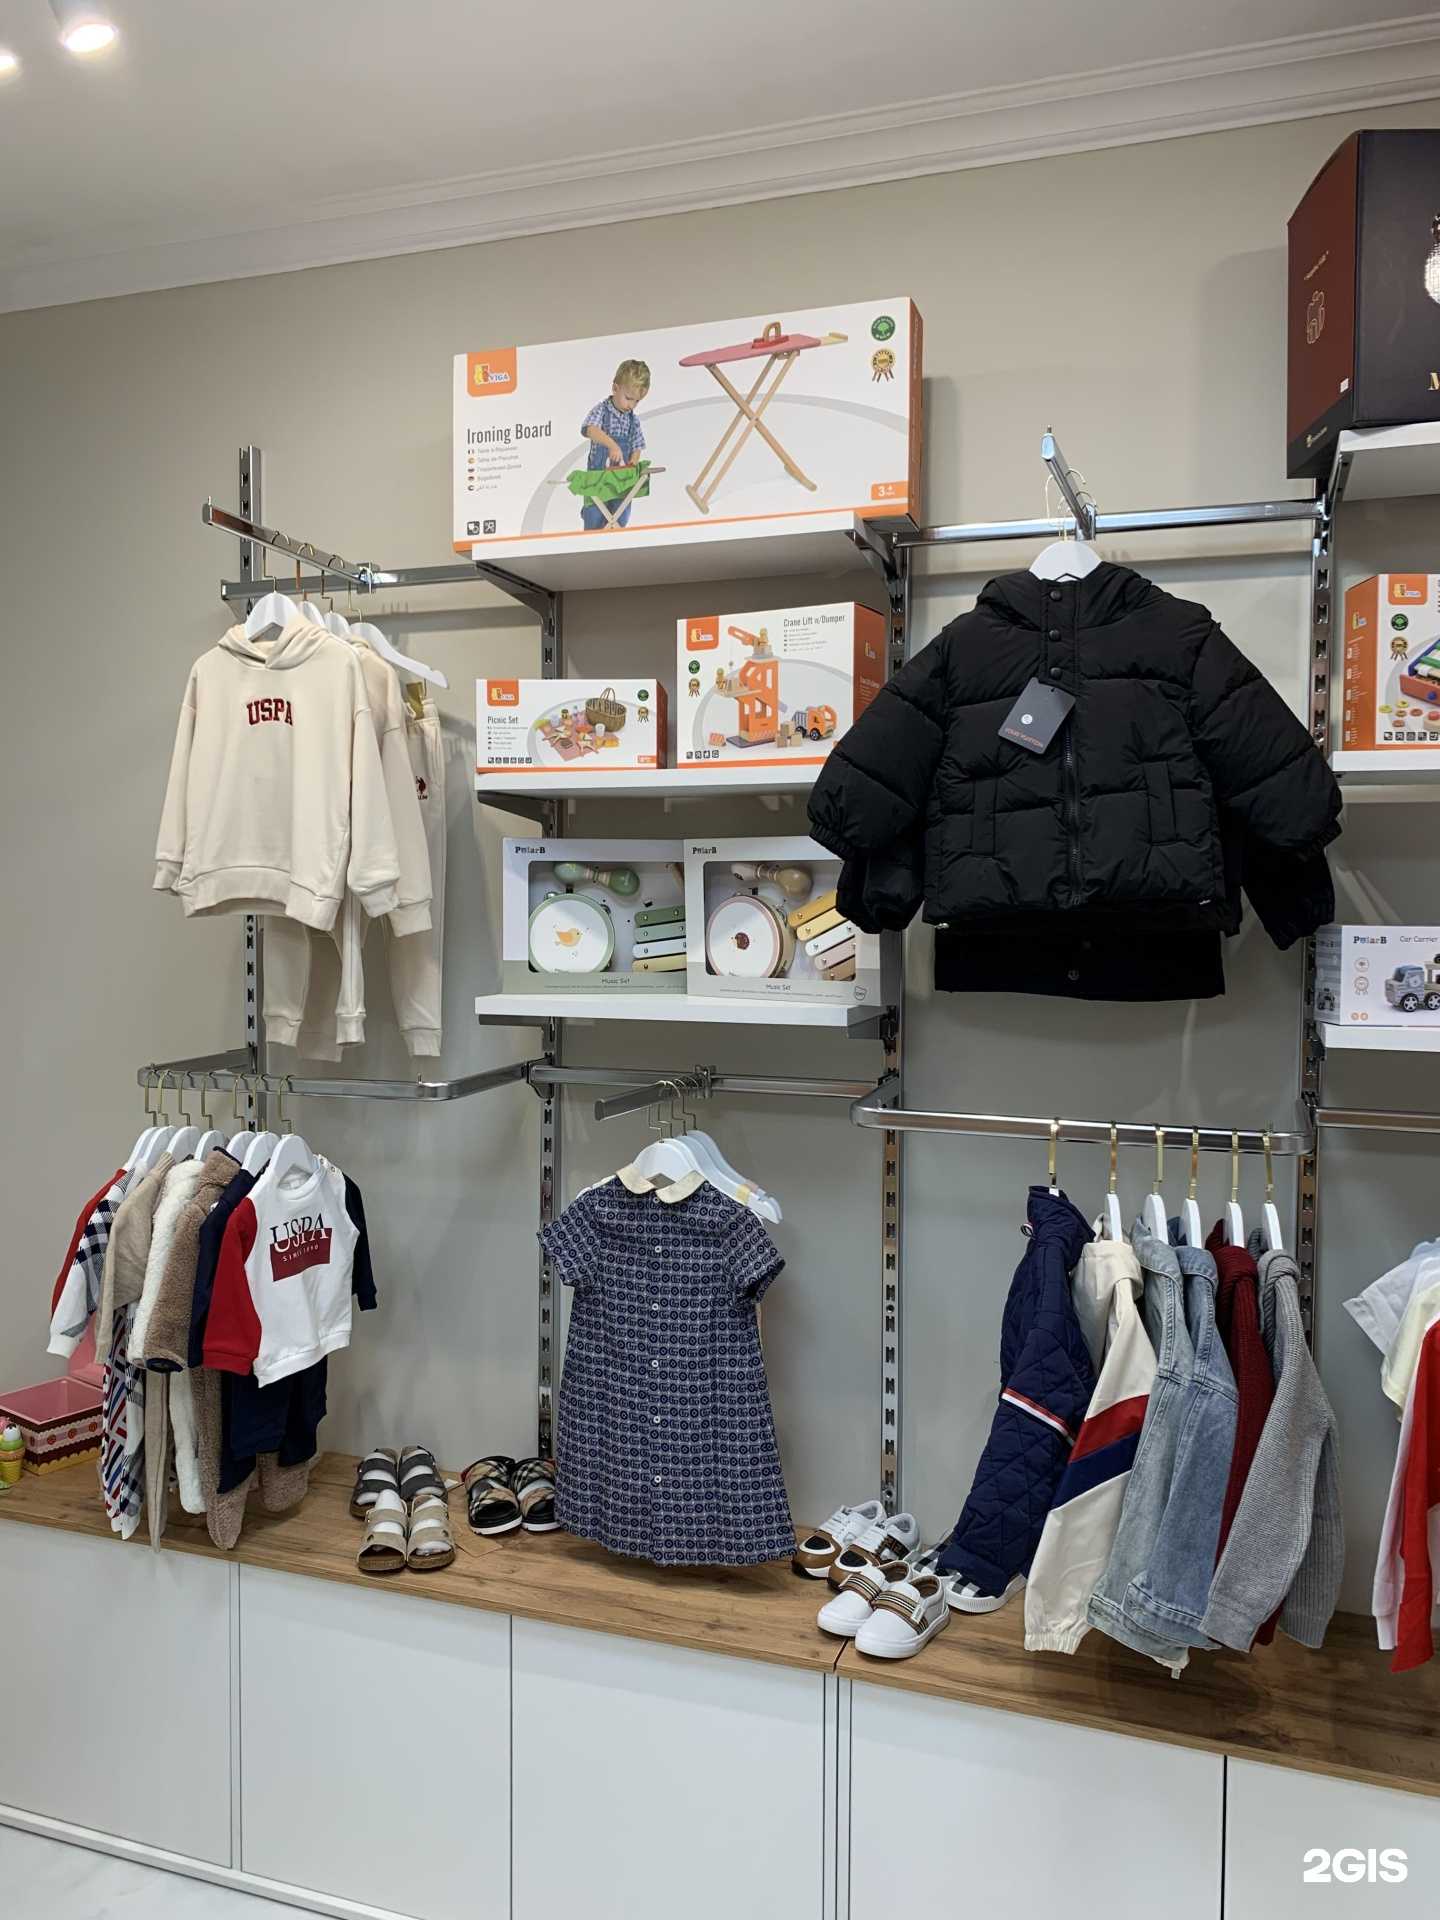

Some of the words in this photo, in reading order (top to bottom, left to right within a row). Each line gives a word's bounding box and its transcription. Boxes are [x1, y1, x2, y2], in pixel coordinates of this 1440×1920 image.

[467, 426, 511, 444] Ironing
[515, 420, 551, 440] Board
[783, 619, 801, 627] Crane
[803, 616, 813, 625] Lift
[246, 698, 293, 726] USPA
[487, 716, 507, 724] Picnic
[508, 716, 518, 724] Set
[515, 846, 546, 854] PolarB
[1353, 936, 1387, 944] PolarB
[270, 1213, 329, 1253] USPA
